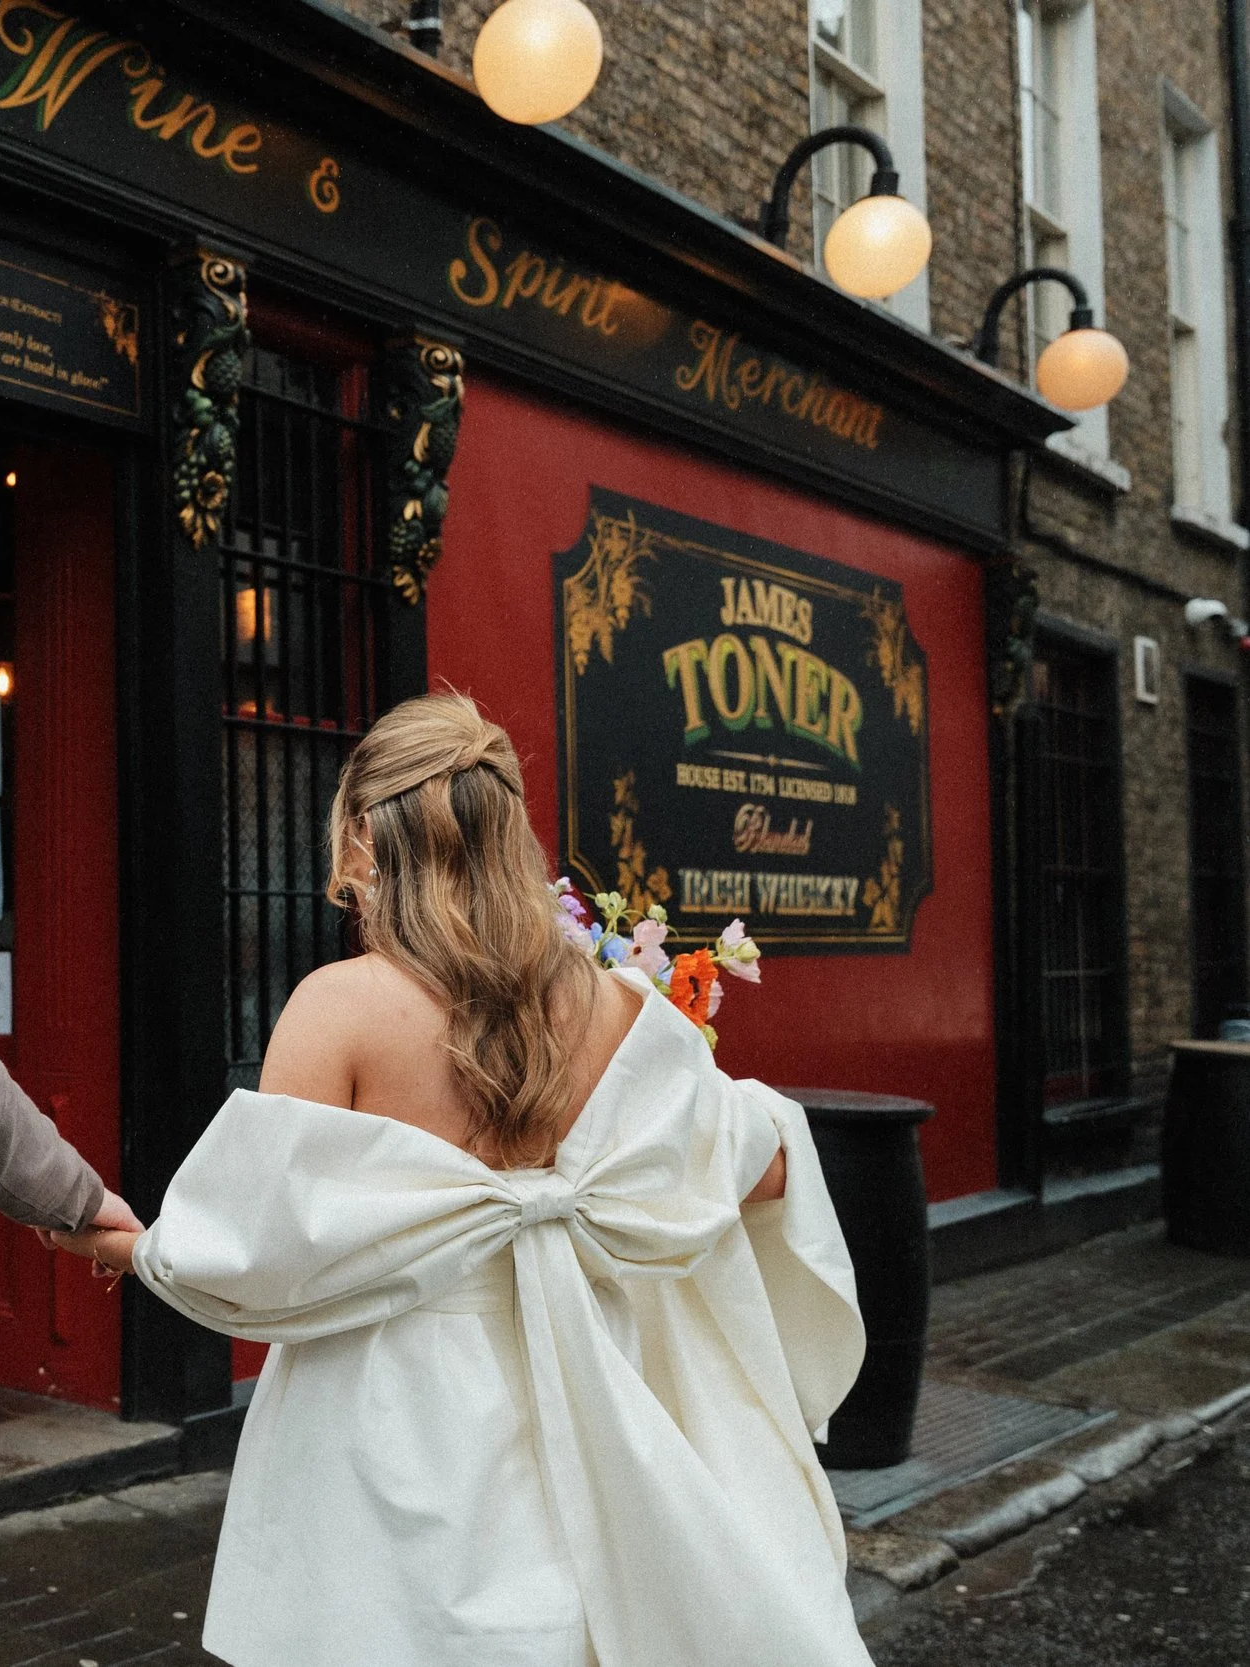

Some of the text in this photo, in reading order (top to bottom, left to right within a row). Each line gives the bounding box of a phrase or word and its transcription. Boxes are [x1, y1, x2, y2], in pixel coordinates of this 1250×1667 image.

[308, 155, 341, 213] &
[450, 217, 886, 450] Spirit Merchant
[0, 353, 22, 368] are
[23, 354, 56, 378] hand
[56, 367, 70, 381] in
[720, 577, 814, 645] JAMES
[662, 632, 863, 772] TONER
[676, 762, 721, 790] HOUSE
[778, 776, 833, 804] LICENSED
[678, 867, 751, 914] IRISH
